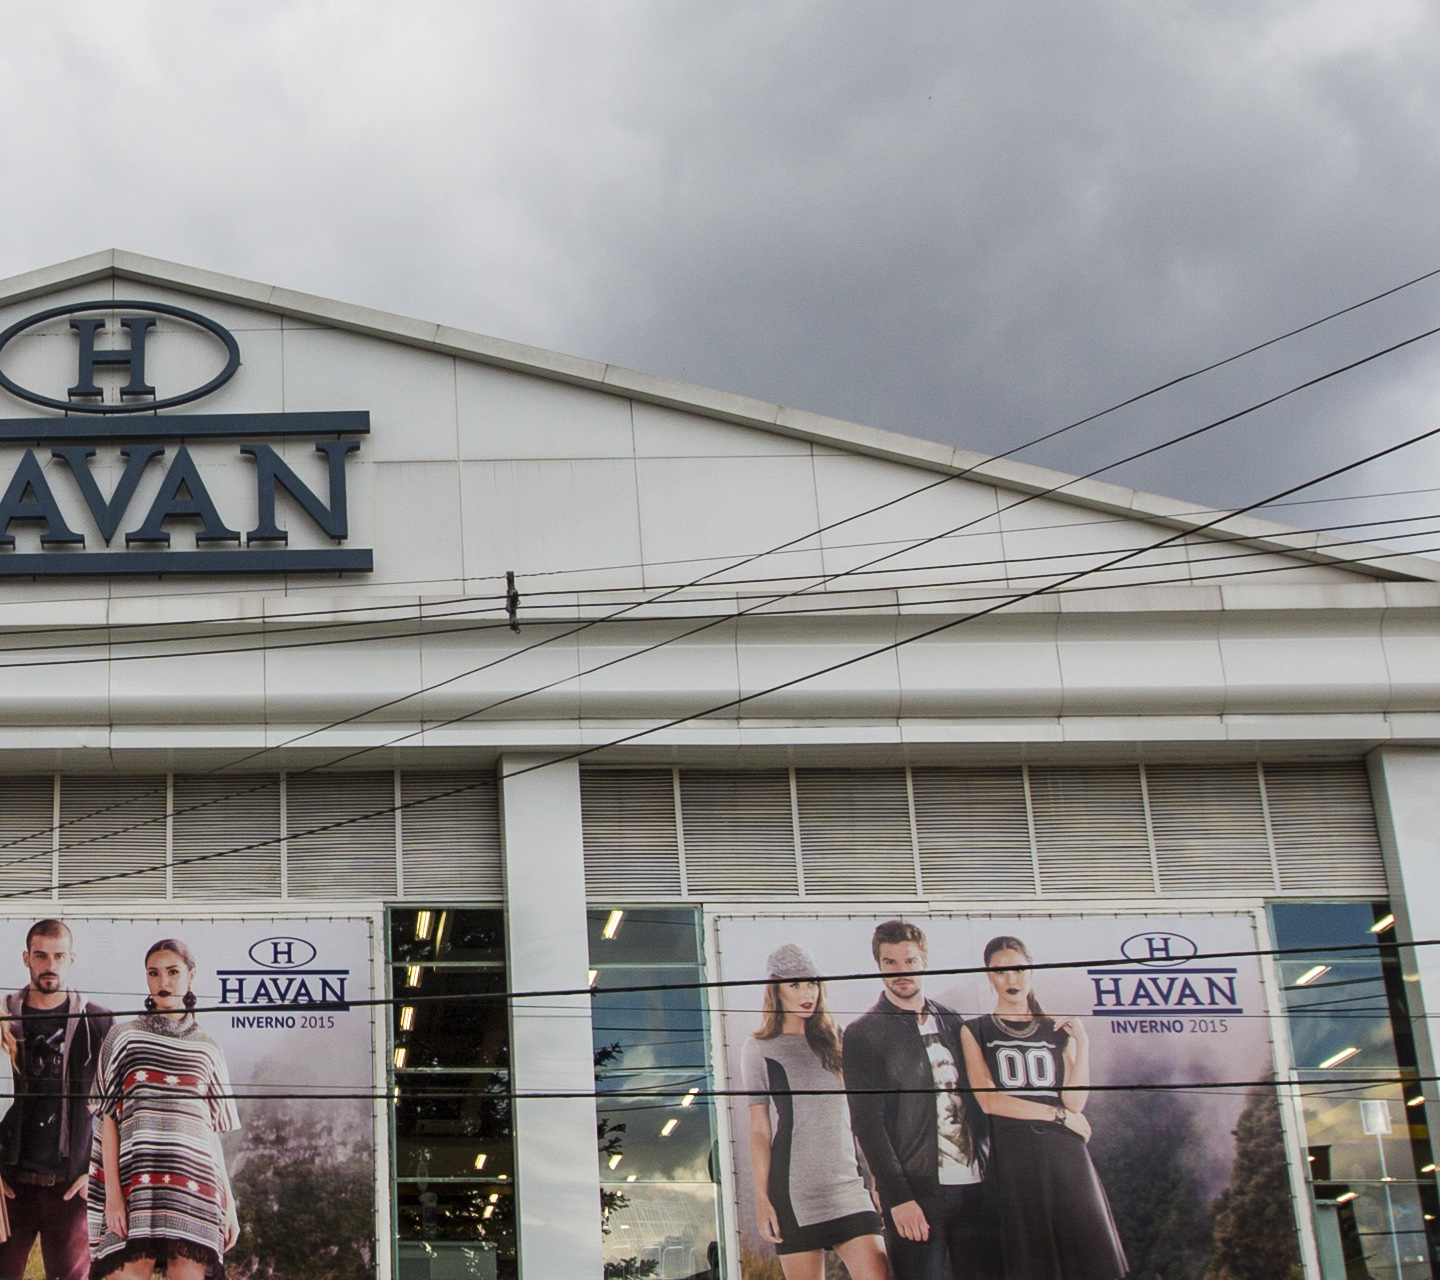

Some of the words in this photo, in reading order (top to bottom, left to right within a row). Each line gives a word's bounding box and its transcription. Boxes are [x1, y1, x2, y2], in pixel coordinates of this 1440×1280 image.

[67, 318, 158, 397] H
[270, 942, 295, 964] H
[1144, 937, 1172, 961] H
[218, 977, 347, 1004] HAVAN
[1090, 977, 1237, 1006] HAVAN
[231, 1016, 296, 1028] INVERNO
[300, 1016, 335, 1028] 2015
[1111, 1020, 1184, 1033] INVERNO
[1189, 1020, 1228, 1033] 2015
[996, 1048, 1056, 1088] 00
